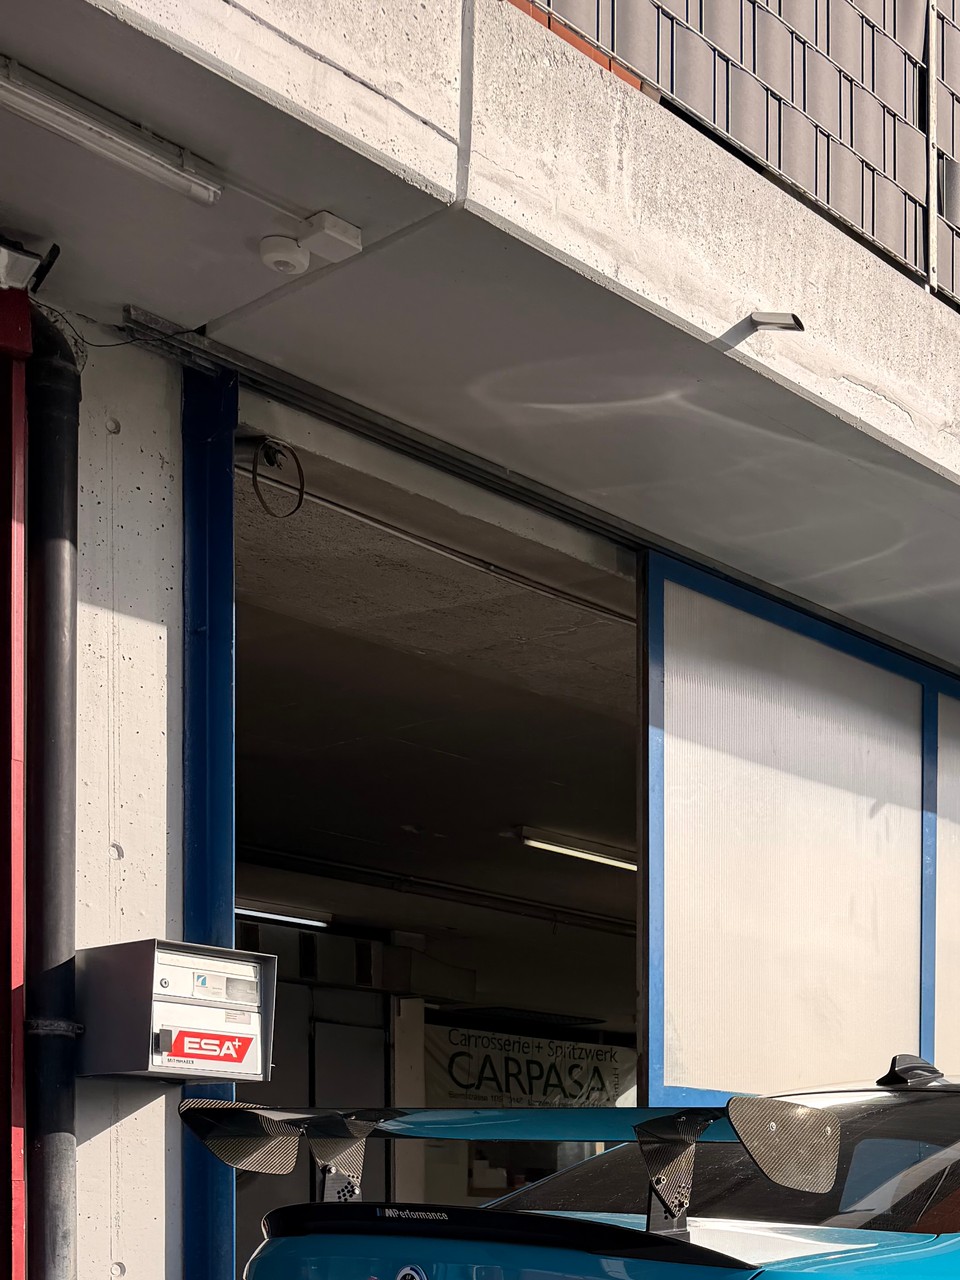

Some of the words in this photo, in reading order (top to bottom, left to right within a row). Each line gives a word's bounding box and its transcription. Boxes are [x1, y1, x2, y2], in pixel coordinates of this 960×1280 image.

[447, 1028, 531, 1055] Carrosserie
[535, 1041, 544, 1054] +
[547, 1040, 619, 1064] Spritzwerk
[447, 1051, 611, 1102] CARPASA
